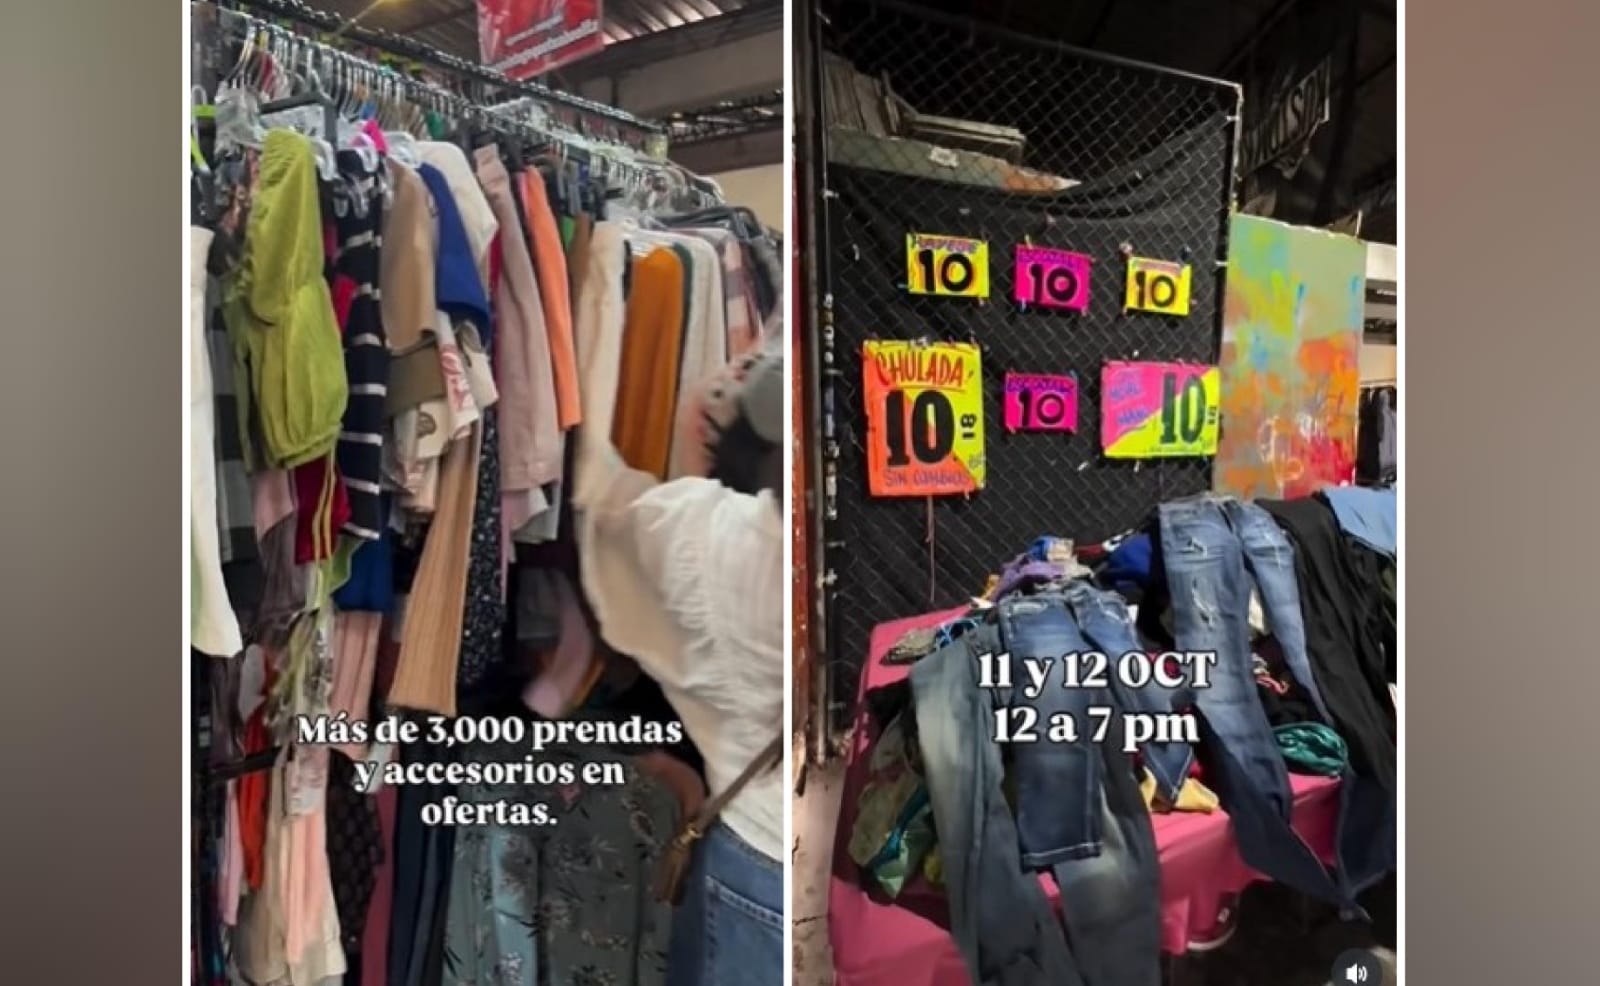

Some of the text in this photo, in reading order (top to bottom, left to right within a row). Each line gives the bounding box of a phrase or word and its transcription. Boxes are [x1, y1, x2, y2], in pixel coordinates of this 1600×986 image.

[919, 249, 973, 293] 10
[1030, 263, 1077, 302] 10
[1135, 270, 1176, 309] 10
[1018, 387, 1065, 426] 10
[1159, 372, 1206, 444] 10
[886, 389, 955, 467] 10
